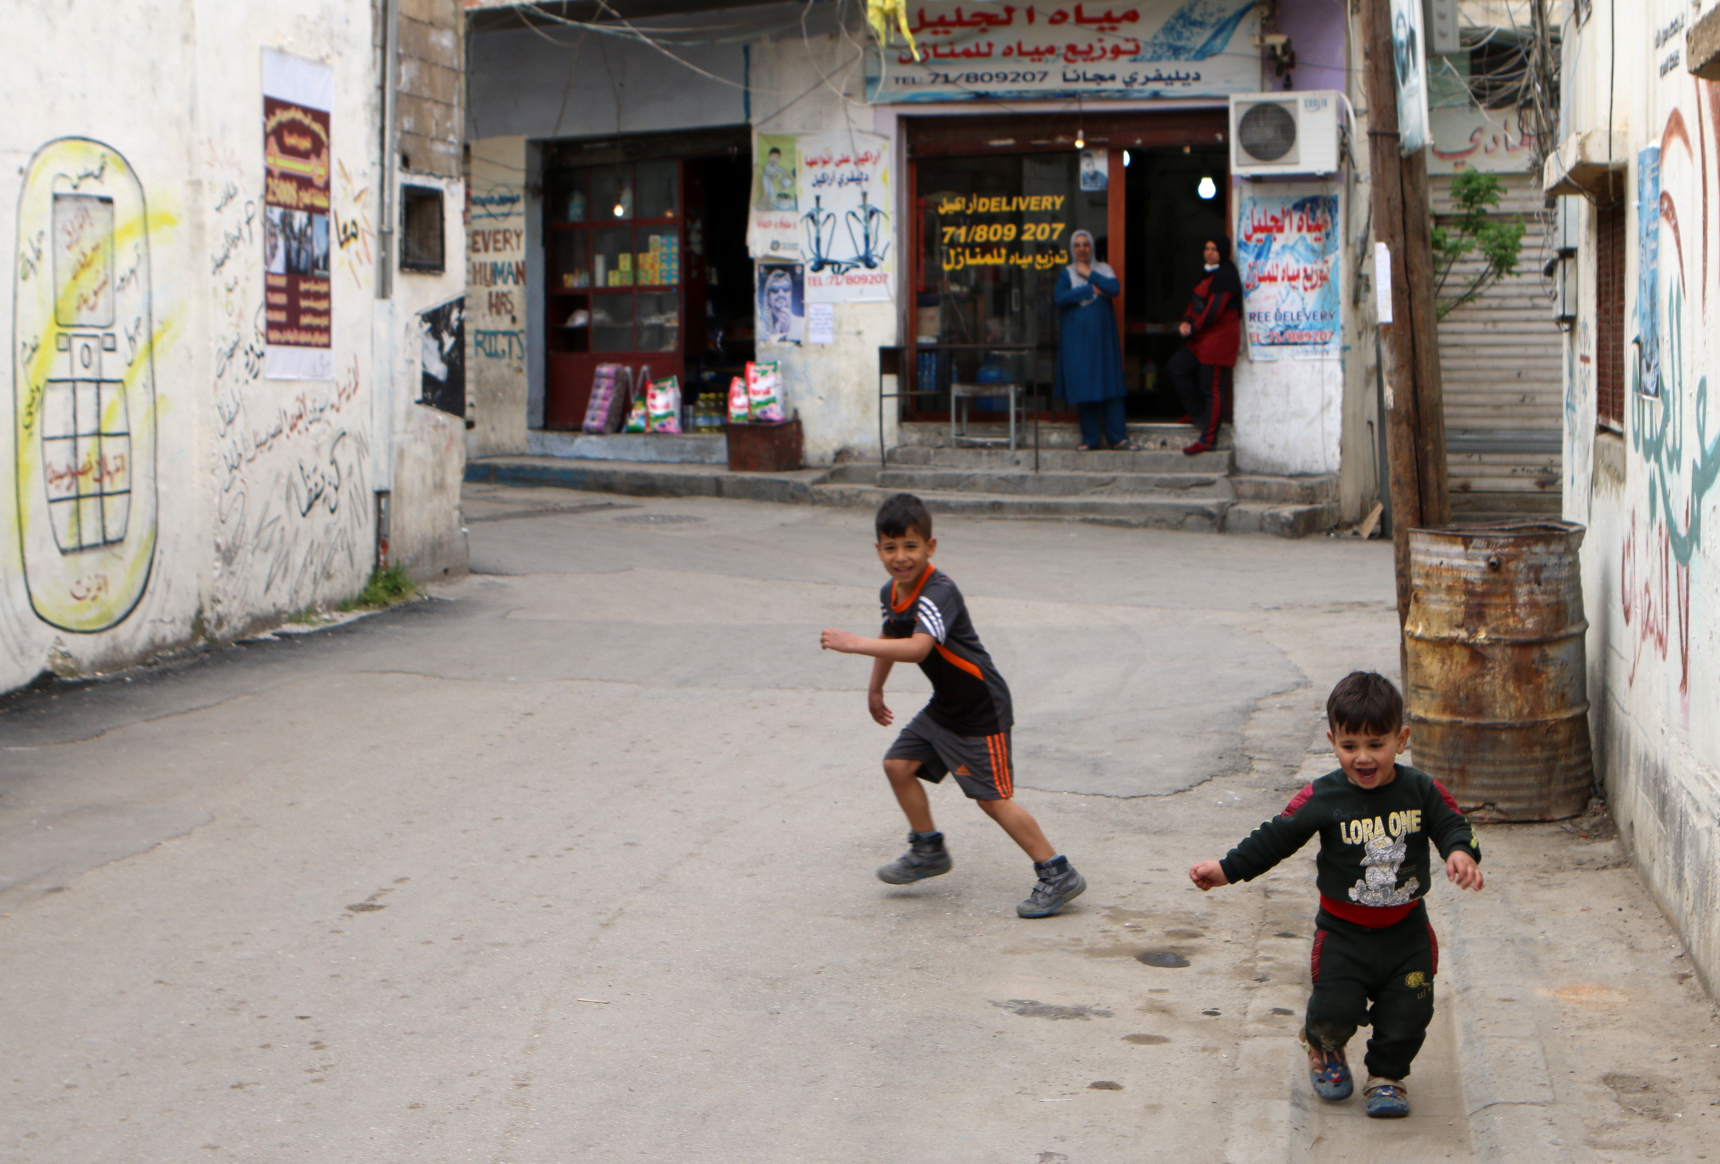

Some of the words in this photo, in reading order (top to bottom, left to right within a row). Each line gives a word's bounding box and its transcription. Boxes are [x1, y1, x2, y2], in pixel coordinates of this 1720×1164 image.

[896, 6, 1036, 35] الجليل
[1047, 3, 1141, 33] مياه
[1001, 40, 1057, 62] مياه
[1063, 37, 1142, 64] توزيع
[928, 71, 1049, 85] 71/809207
[978, 195, 1065, 212] DELIVERY
[471, 229, 523, 253] EVERY
[942, 224, 1017, 243] 71/809
[1021, 223, 1065, 241] 207
[942, 247, 1007, 271] للمنازل
[472, 260, 527, 287] HUMAN
[1248, 311, 1272, 322] REE
[1340, 816, 1386, 845] LORA
[1388, 809, 1421, 838] ONE
